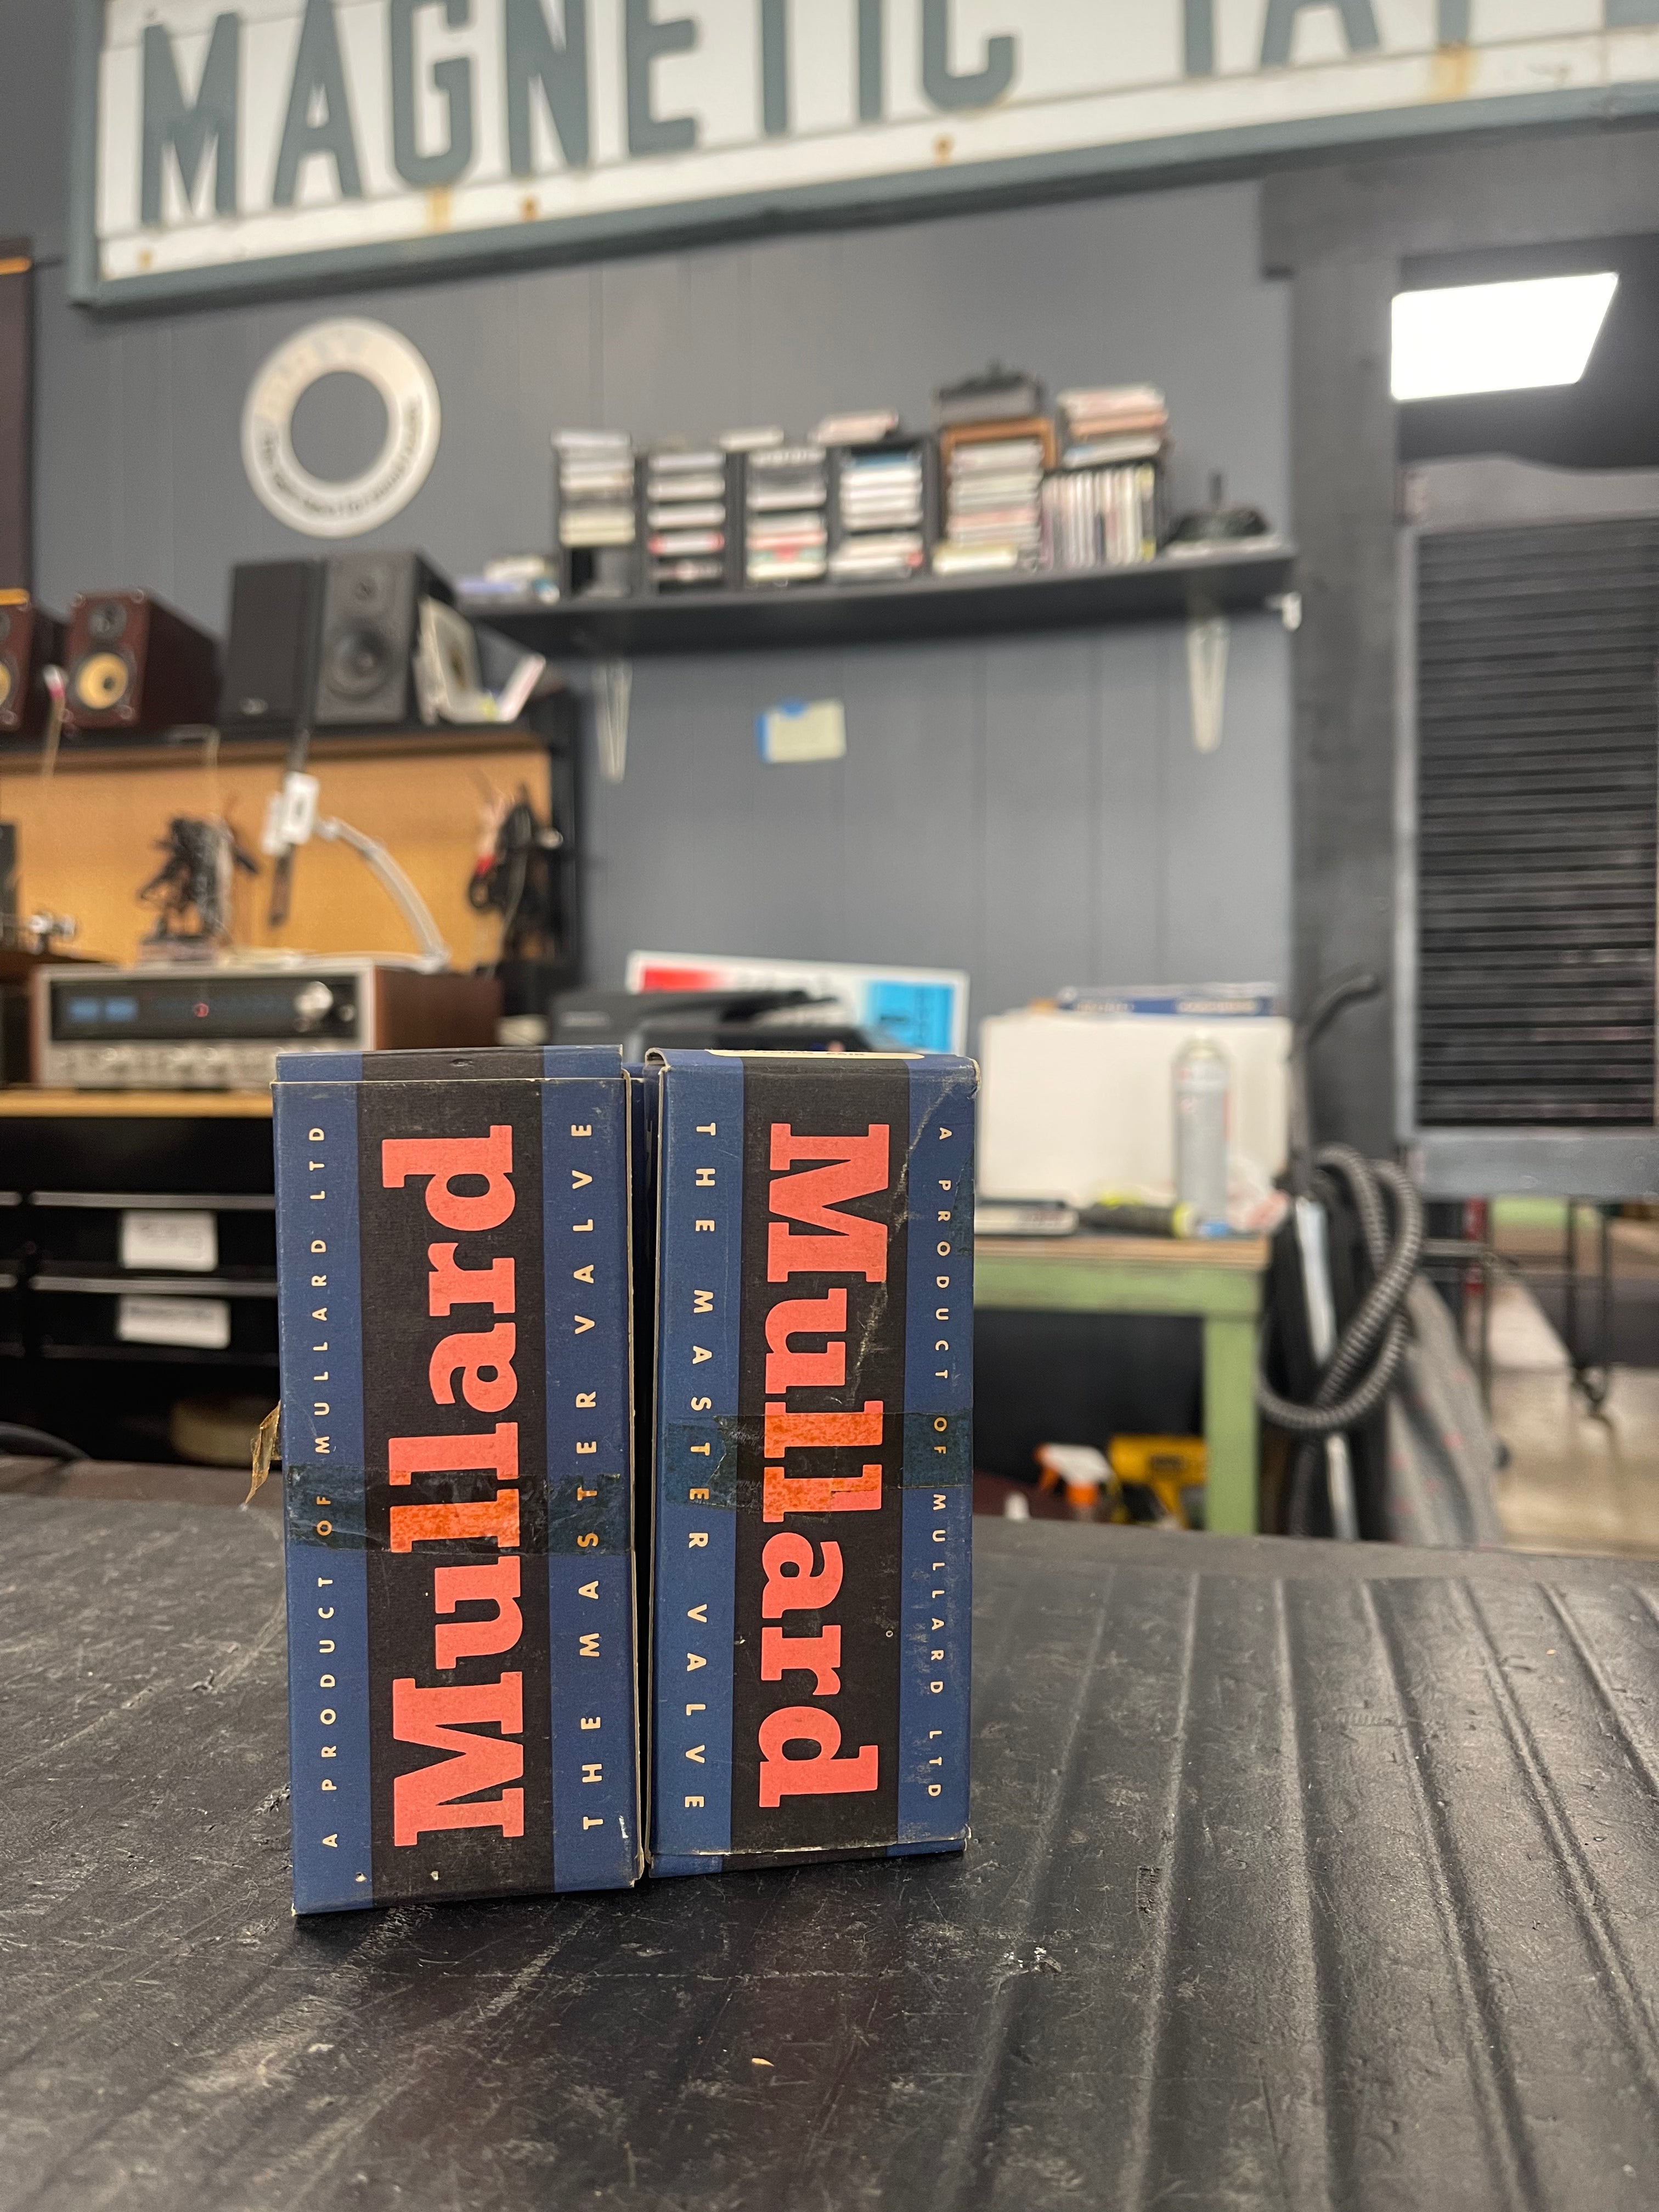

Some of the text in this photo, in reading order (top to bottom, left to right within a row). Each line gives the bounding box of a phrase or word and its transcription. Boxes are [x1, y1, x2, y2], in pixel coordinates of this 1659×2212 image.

[308, 1127, 338, 1848] A PRODUCT OF MULLARD LTD
[381, 1125, 524, 1846] Mullard
[571, 1124, 603, 1830] THE MASTER VALVE
[684, 1122, 716, 1808] THE MASTER VALVE
[758, 1123, 890, 1807] Mullard
[928, 1127, 952, 1797] A PRODUCT OF MULLARD LTD
